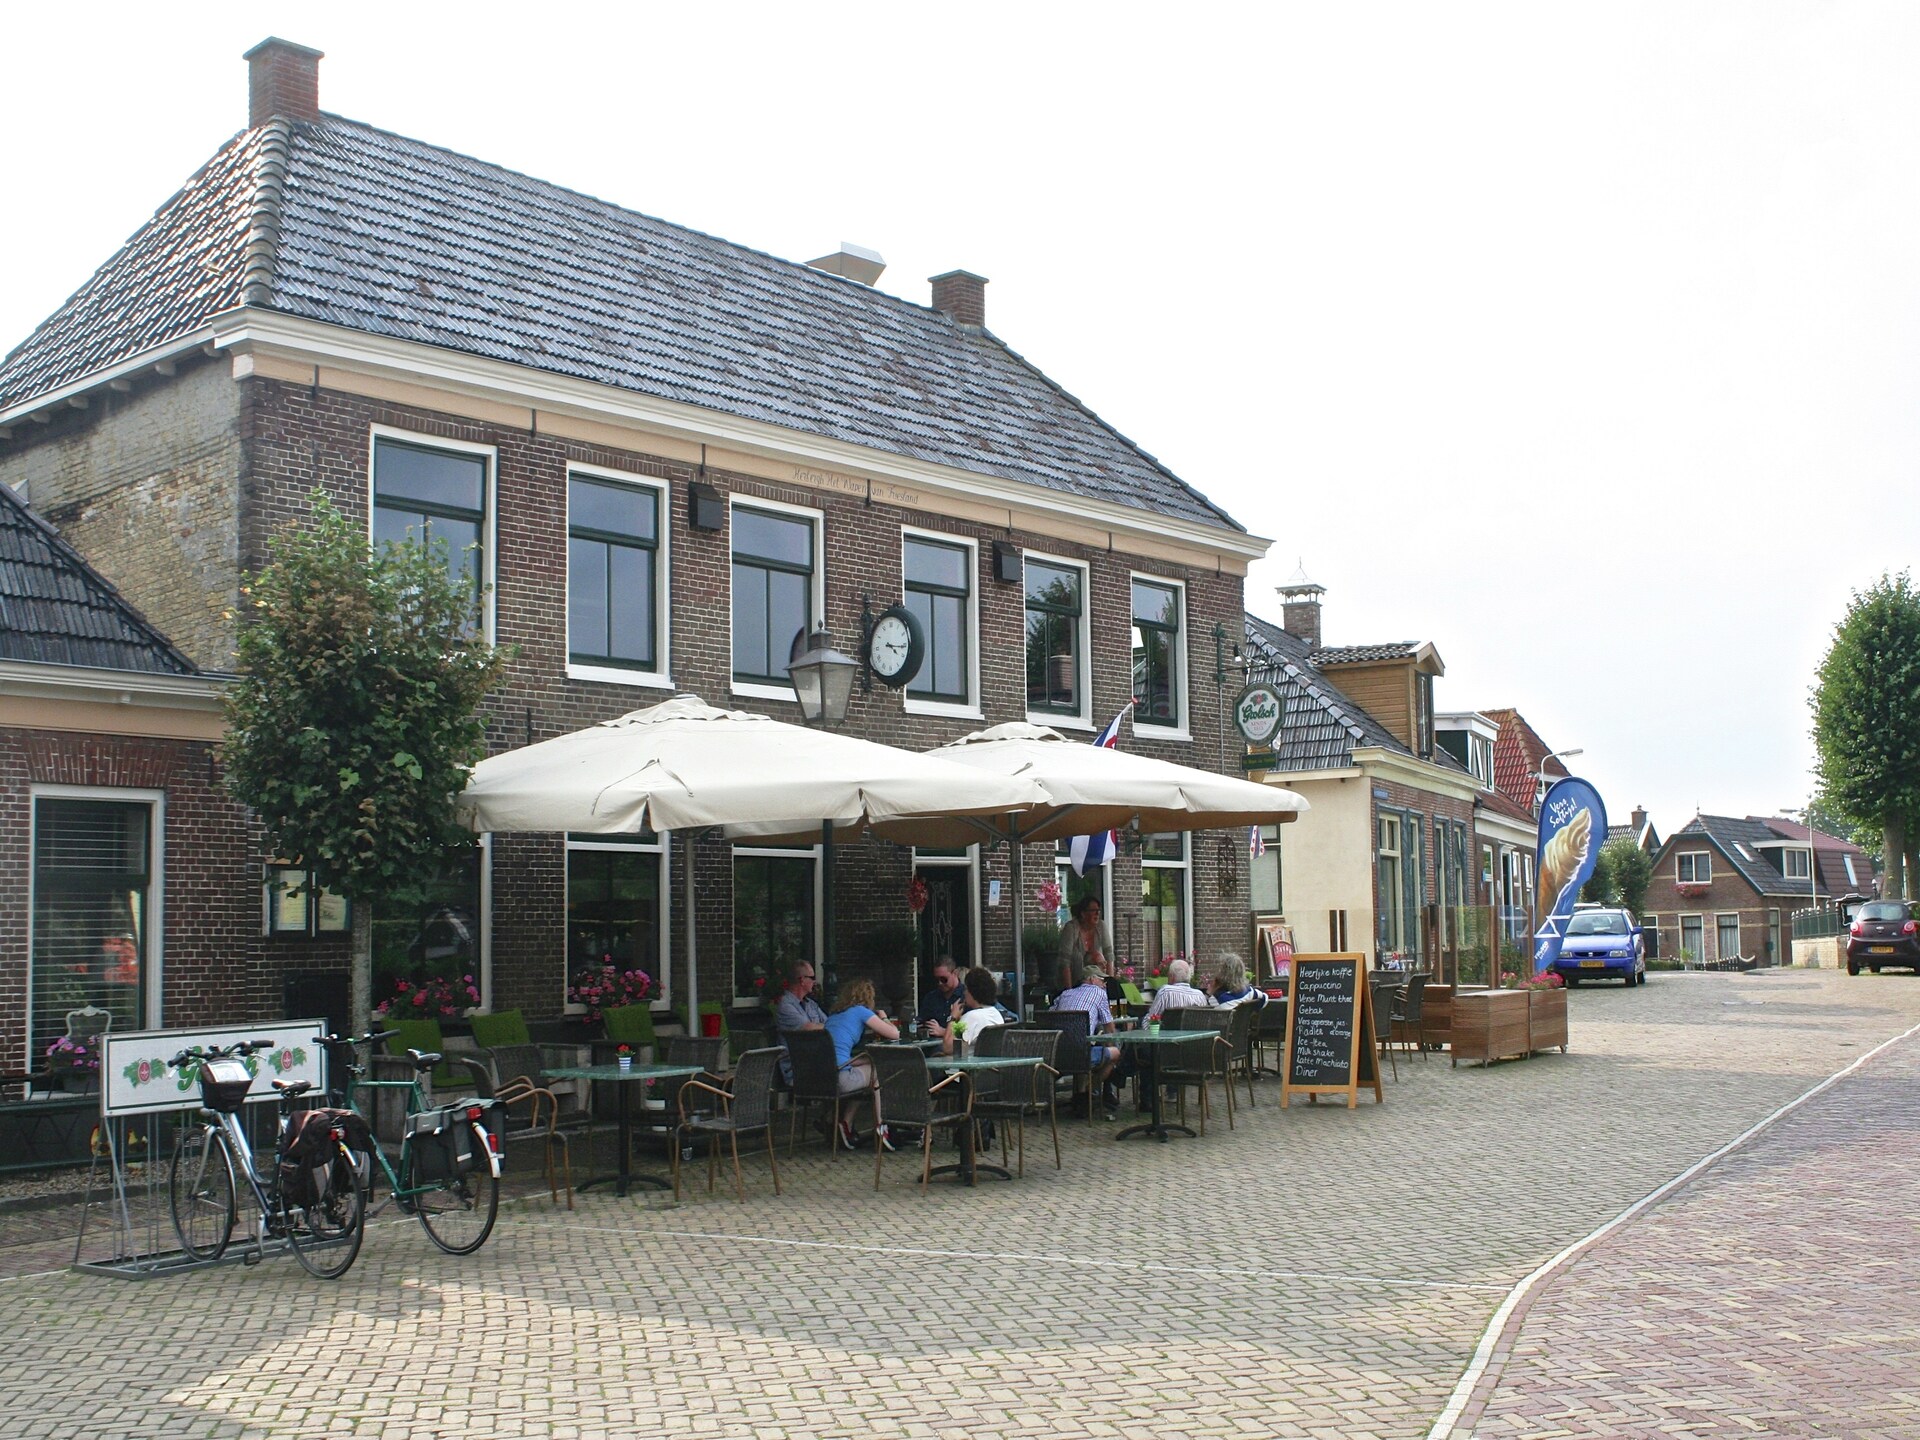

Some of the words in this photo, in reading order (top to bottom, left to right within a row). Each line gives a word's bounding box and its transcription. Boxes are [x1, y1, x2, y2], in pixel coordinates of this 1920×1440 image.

[1241, 703, 1276, 723] Grolsch
[1298, 1004, 1324, 1015] Gebak
[1295, 1065, 1318, 1077] Diner
